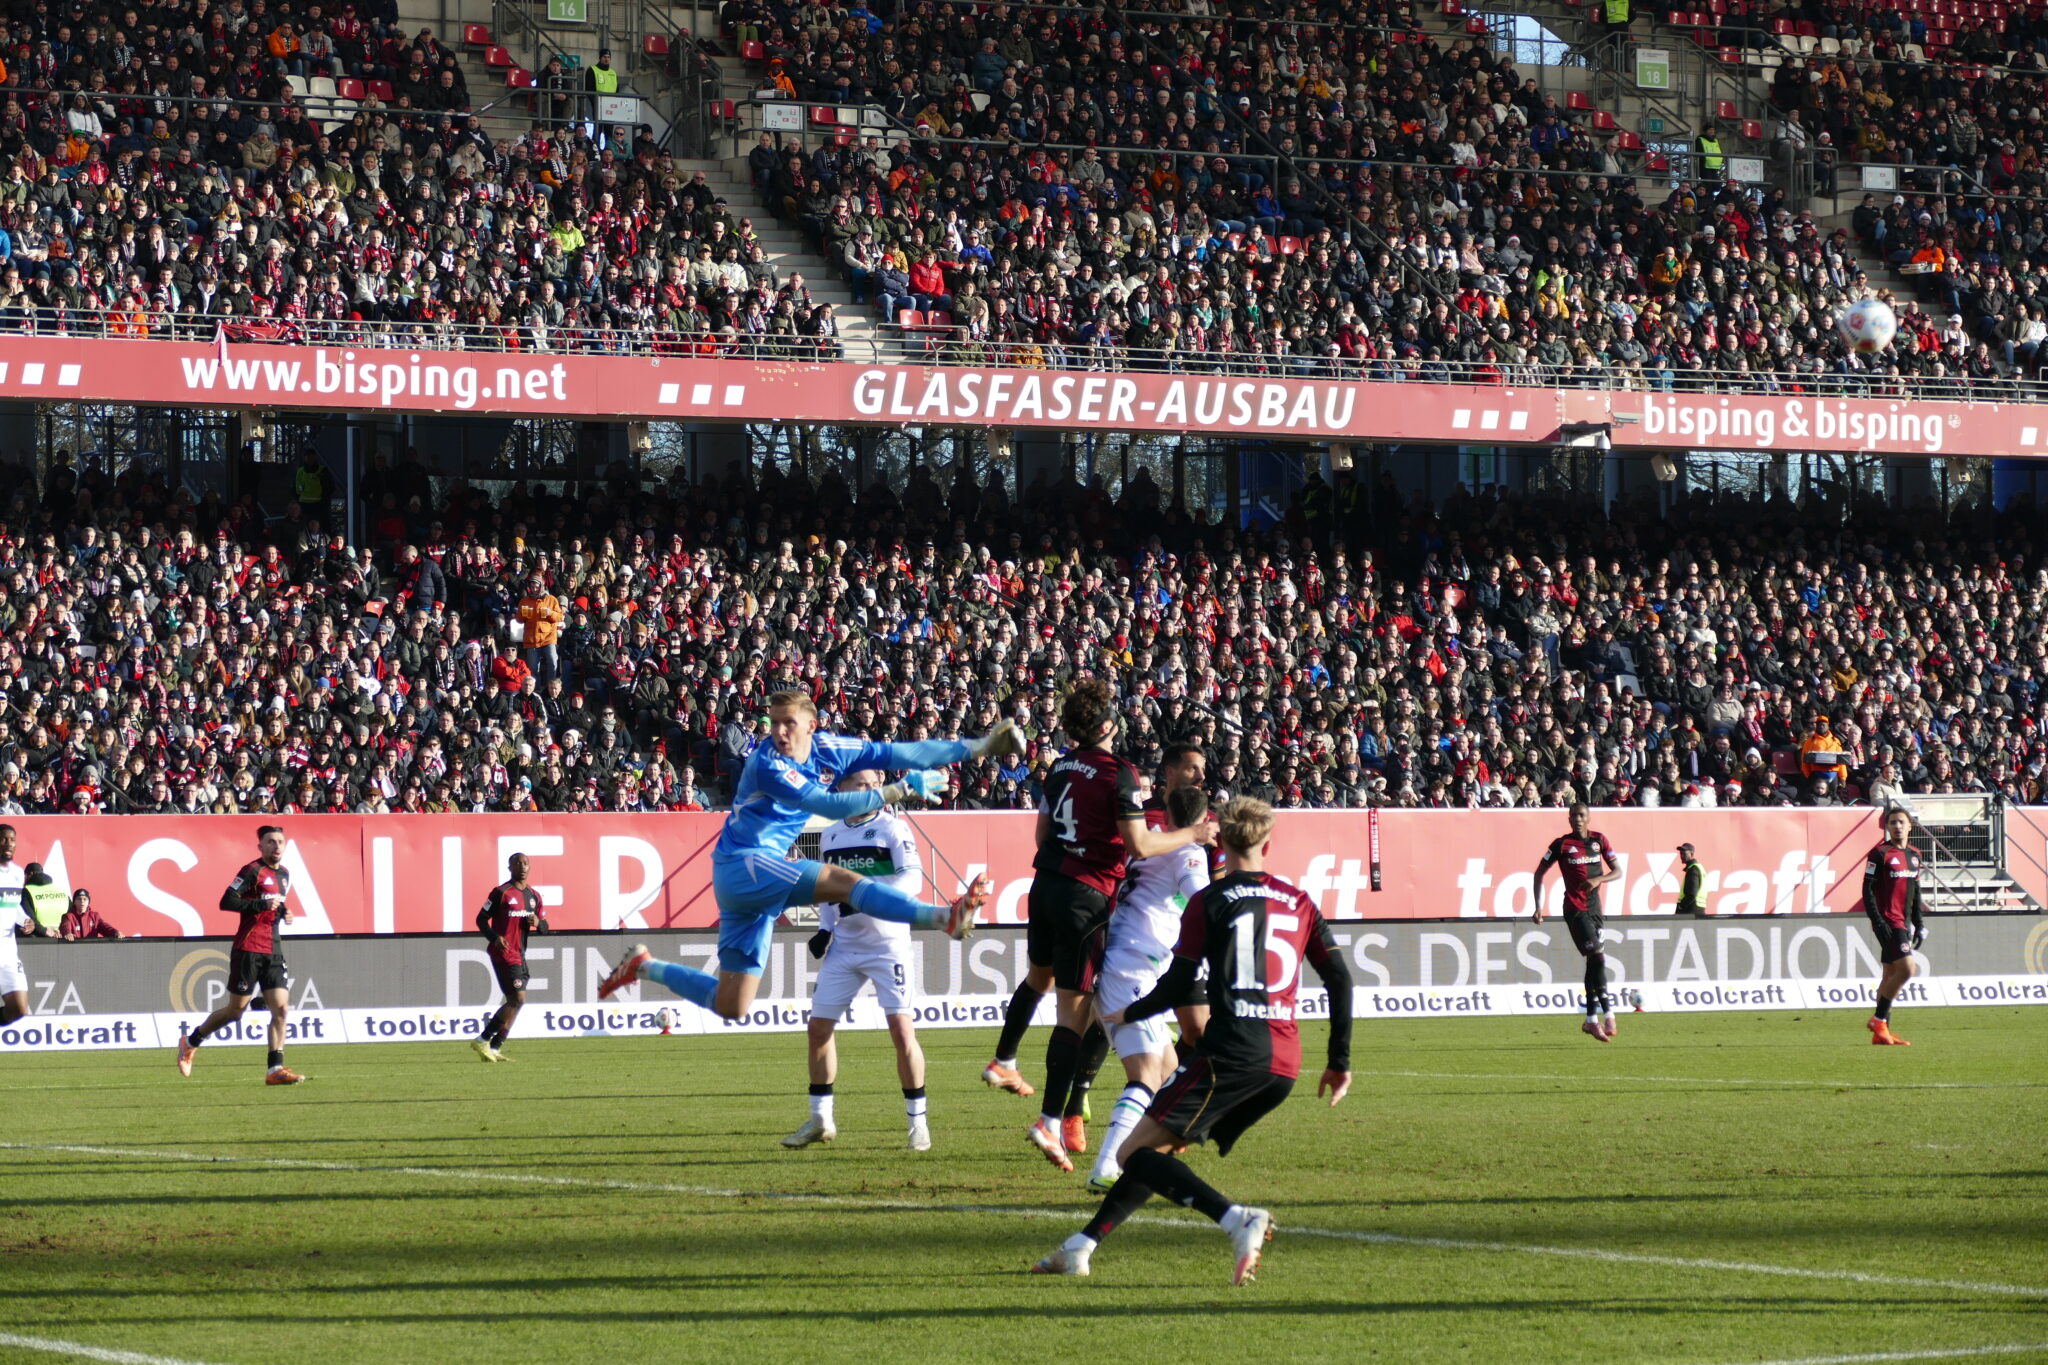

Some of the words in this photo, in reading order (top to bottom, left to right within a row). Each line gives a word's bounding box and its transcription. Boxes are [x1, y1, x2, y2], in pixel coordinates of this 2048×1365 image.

[559, 2, 576, 17] 16
[1646, 71, 1661, 84] 18
[181, 350, 567, 409] www.bisping.net
[853, 370, 1356, 429] GLASFASER-AUSBAU
[1643, 395, 1775, 447] bisping
[1782, 400, 1810, 437] &
[1816, 400, 1943, 452] bisping
[1053, 782, 1078, 842] 4
[838, 854, 875, 870] heise
[1457, 850, 1836, 918] tolcaft
[1223, 885, 1297, 911] Nürnberg
[1228, 912, 1299, 993] 15
[893, 964, 905, 986] 9
[1373, 991, 1492, 1012] toolcraft
[1523, 987, 1632, 1009] toolcaf
[1672, 985, 1785, 1006] toolcraft
[1817, 982, 1929, 1003] toolcaft
[1957, 981, 2048, 1001] toolcra
[544, 1008, 681, 1031] toolcrat
[723, 1004, 855, 1028] oolcrt
[912, 999, 1010, 1023] oolcraf
[178, 1016, 324, 1041] tolcaft
[365, 1013, 493, 1037] toolcraf
